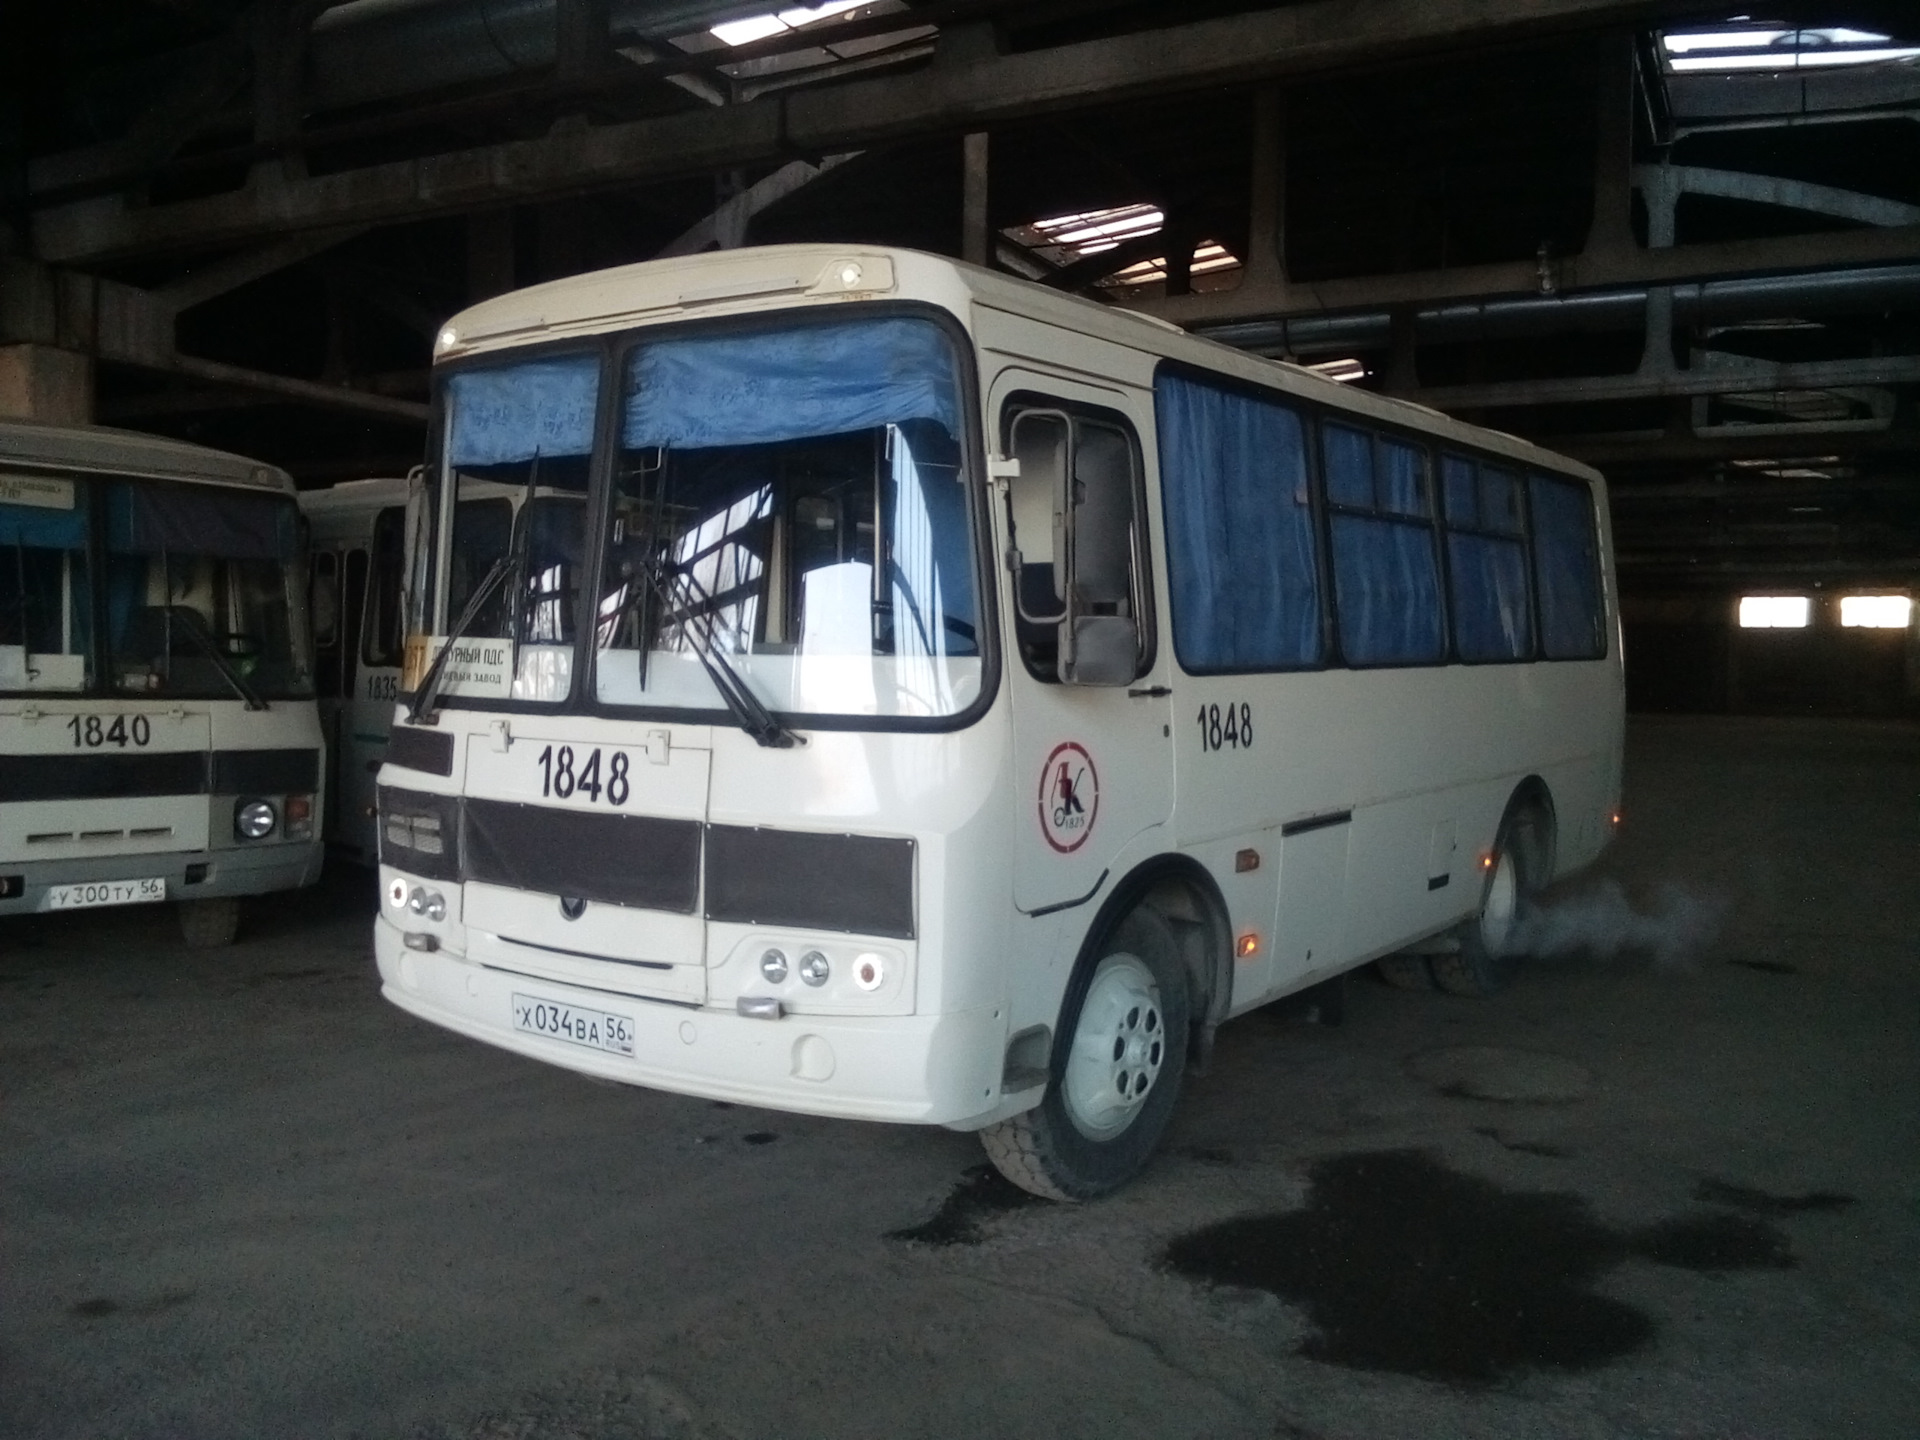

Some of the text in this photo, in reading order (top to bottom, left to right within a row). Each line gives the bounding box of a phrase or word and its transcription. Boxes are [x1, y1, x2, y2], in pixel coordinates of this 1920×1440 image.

[484, 648, 505, 666] ПДС
[367, 676, 397, 702] 1835
[474, 672, 501, 685] ЗАВОД
[67, 713, 151, 748] 1840
[1197, 702, 1253, 753] 1848
[537, 745, 630, 807] 1848
[606, 1017, 627, 1042] 56
